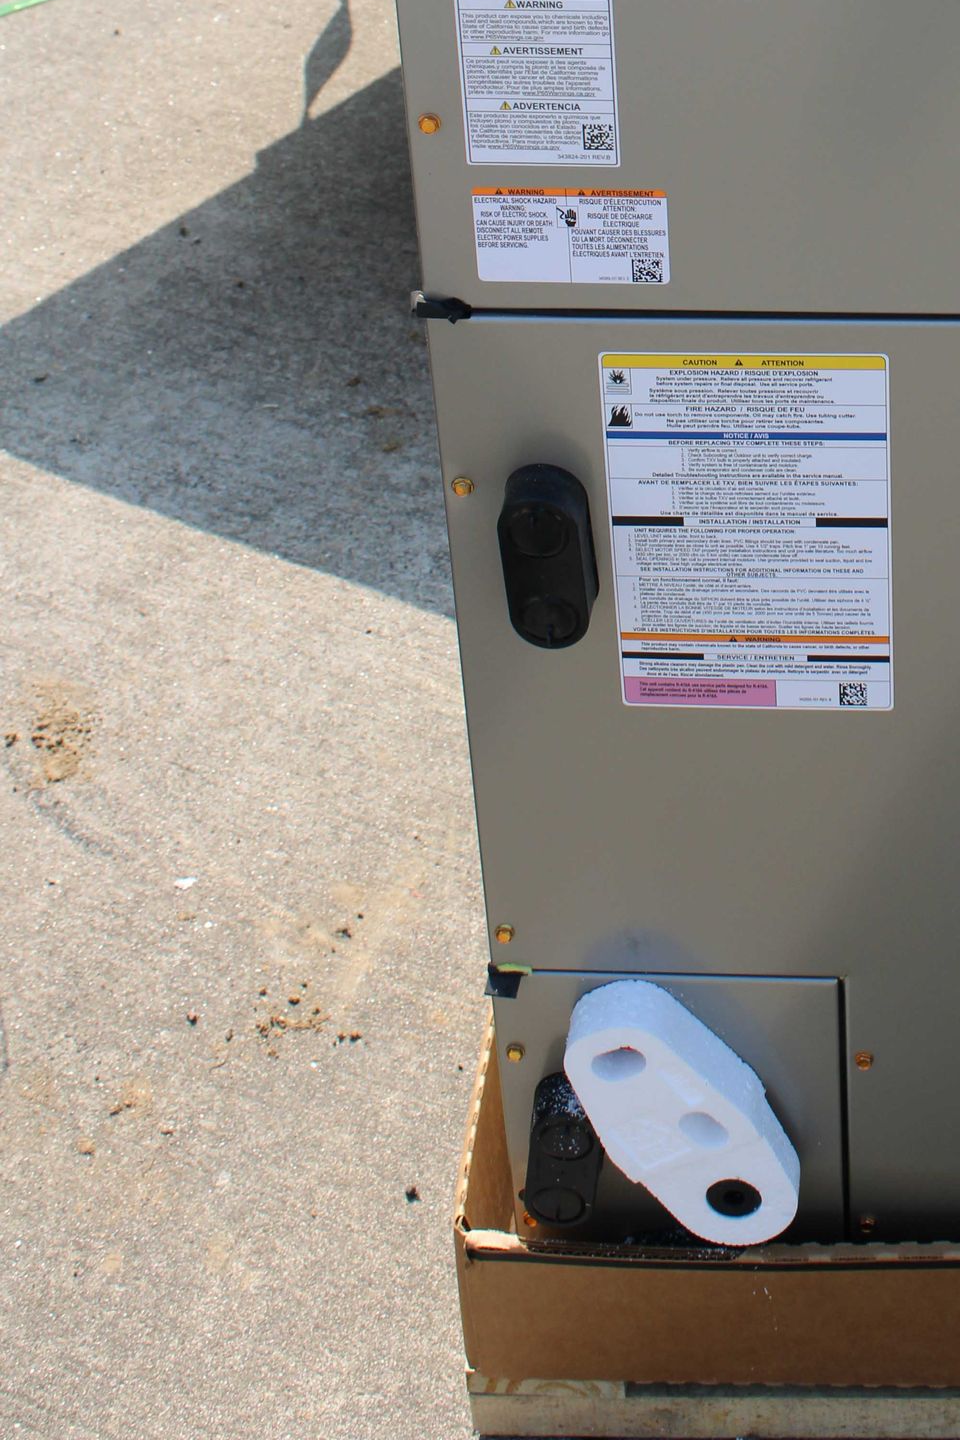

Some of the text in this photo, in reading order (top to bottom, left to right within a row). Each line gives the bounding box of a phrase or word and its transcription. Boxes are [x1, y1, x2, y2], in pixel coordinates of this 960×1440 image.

[503, 47, 583, 55] AVERTISSEMENT
[513, 102, 581, 111] ADVERTENCIA
[754, 654, 795, 662] ENTRETIEN
